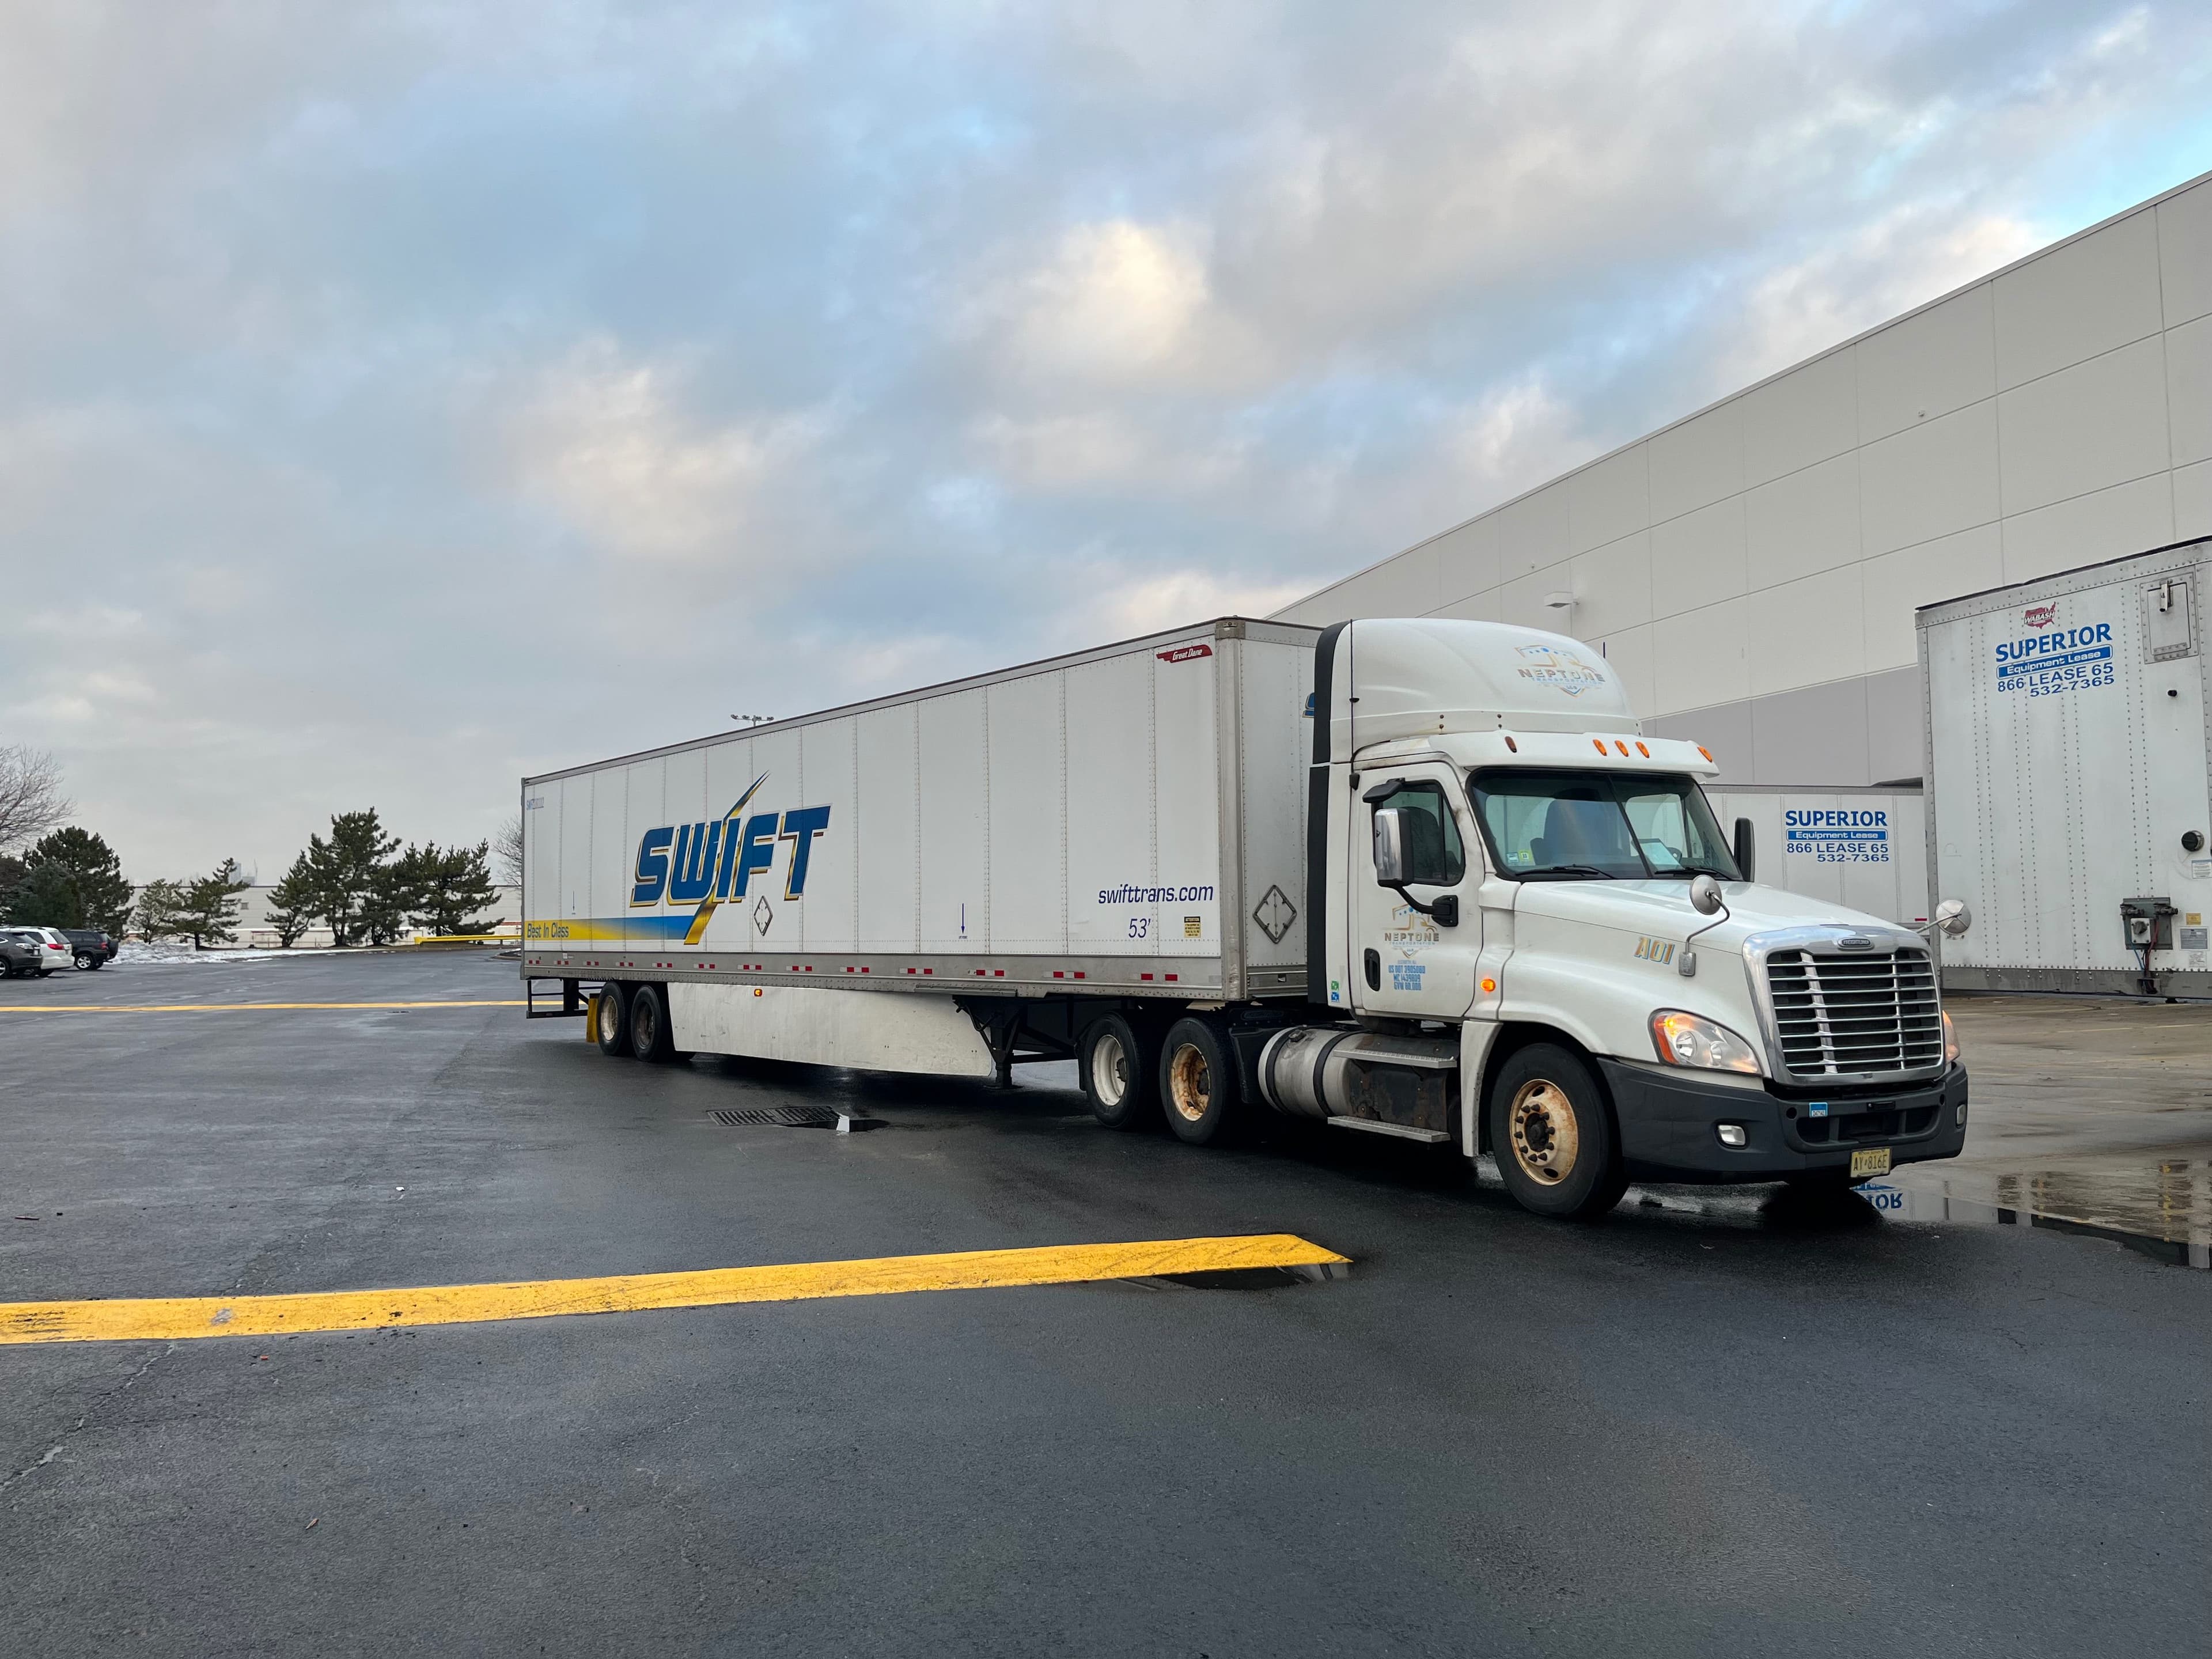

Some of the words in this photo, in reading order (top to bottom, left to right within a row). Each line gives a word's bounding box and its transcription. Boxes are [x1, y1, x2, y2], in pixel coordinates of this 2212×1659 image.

[2024, 611, 2055, 624] WABASH
[1995, 623, 2113, 662] SUPERIOR
[1172, 651, 1188, 661] Great
[1188, 648, 1203, 657] Dane
[2007, 657, 2065, 674] Equipment
[2068, 651, 2101, 663] Lease
[1998, 677, 2024, 692] 866
[2029, 666, 2087, 686] LEASE
[2092, 662, 2113, 676] 65
[2030, 675, 2115, 697] 532-7365
[1786, 810, 1888, 826] SUPERIOR
[1796, 831, 1849, 840] Equipment
[630, 804, 832, 908] SWIFT
[1787, 843, 1812, 853] 866
[1816, 843, 1867, 853] LEASE
[1870, 843, 1888, 853] 65
[1817, 854, 1889, 862] 532-7365
[1099, 884, 1213, 904] swifttrans.com
[527, 923, 541, 938] Best
[543, 922, 549, 938] In
[551, 922, 569, 938] Class
[1128, 918, 1151, 938] 53'
[1388, 965, 1394, 973] US
[1395, 965, 1403, 973] DOT
[1393, 974, 1400, 982] MC
